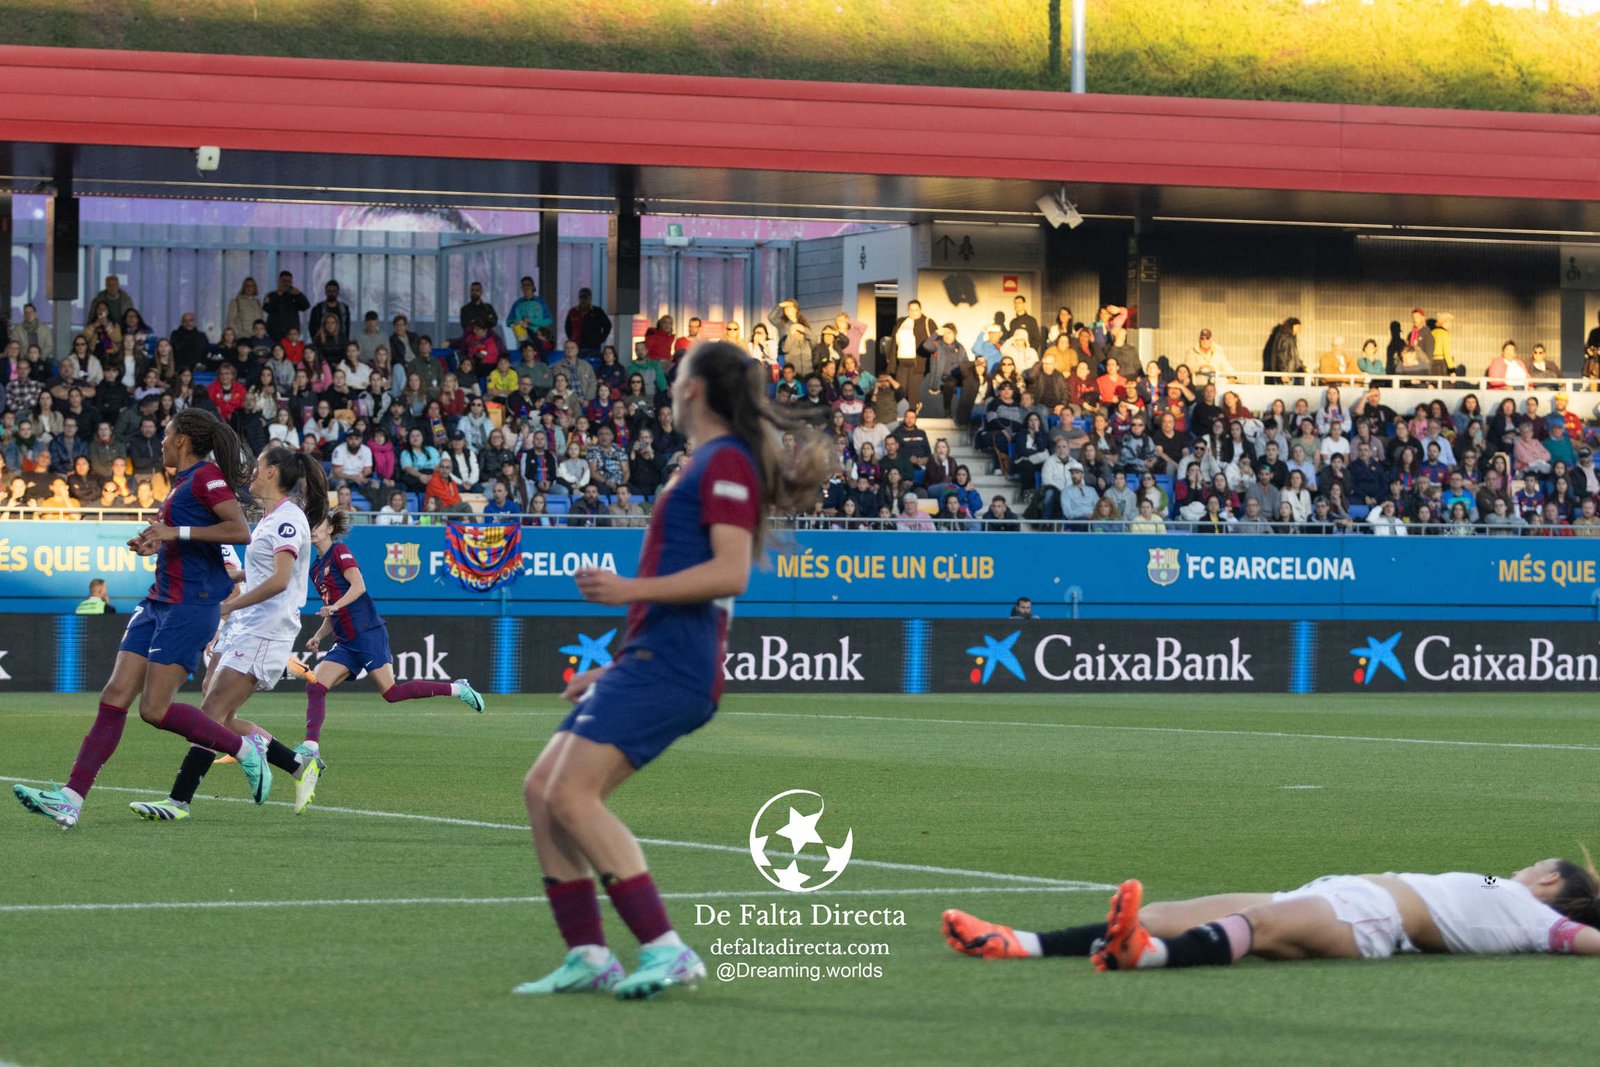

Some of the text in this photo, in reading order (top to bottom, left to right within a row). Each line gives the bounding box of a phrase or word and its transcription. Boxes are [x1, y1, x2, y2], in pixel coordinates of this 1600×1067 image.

[0, 537, 28, 571] ÉS
[33, 545, 91, 577] QUE
[96, 545, 137, 572] UN
[430, 551, 618, 576] F CELONA
[777, 548, 994, 583] MÉS QUE UN CLUB
[1186, 555, 1355, 580] FC BARCELONA
[1499, 553, 1596, 587] MÉS QUE
[721, 635, 865, 681] xaBank
[1034, 634, 1254, 682] CaixaBank
[1414, 635, 1600, 682] CaixaBan
